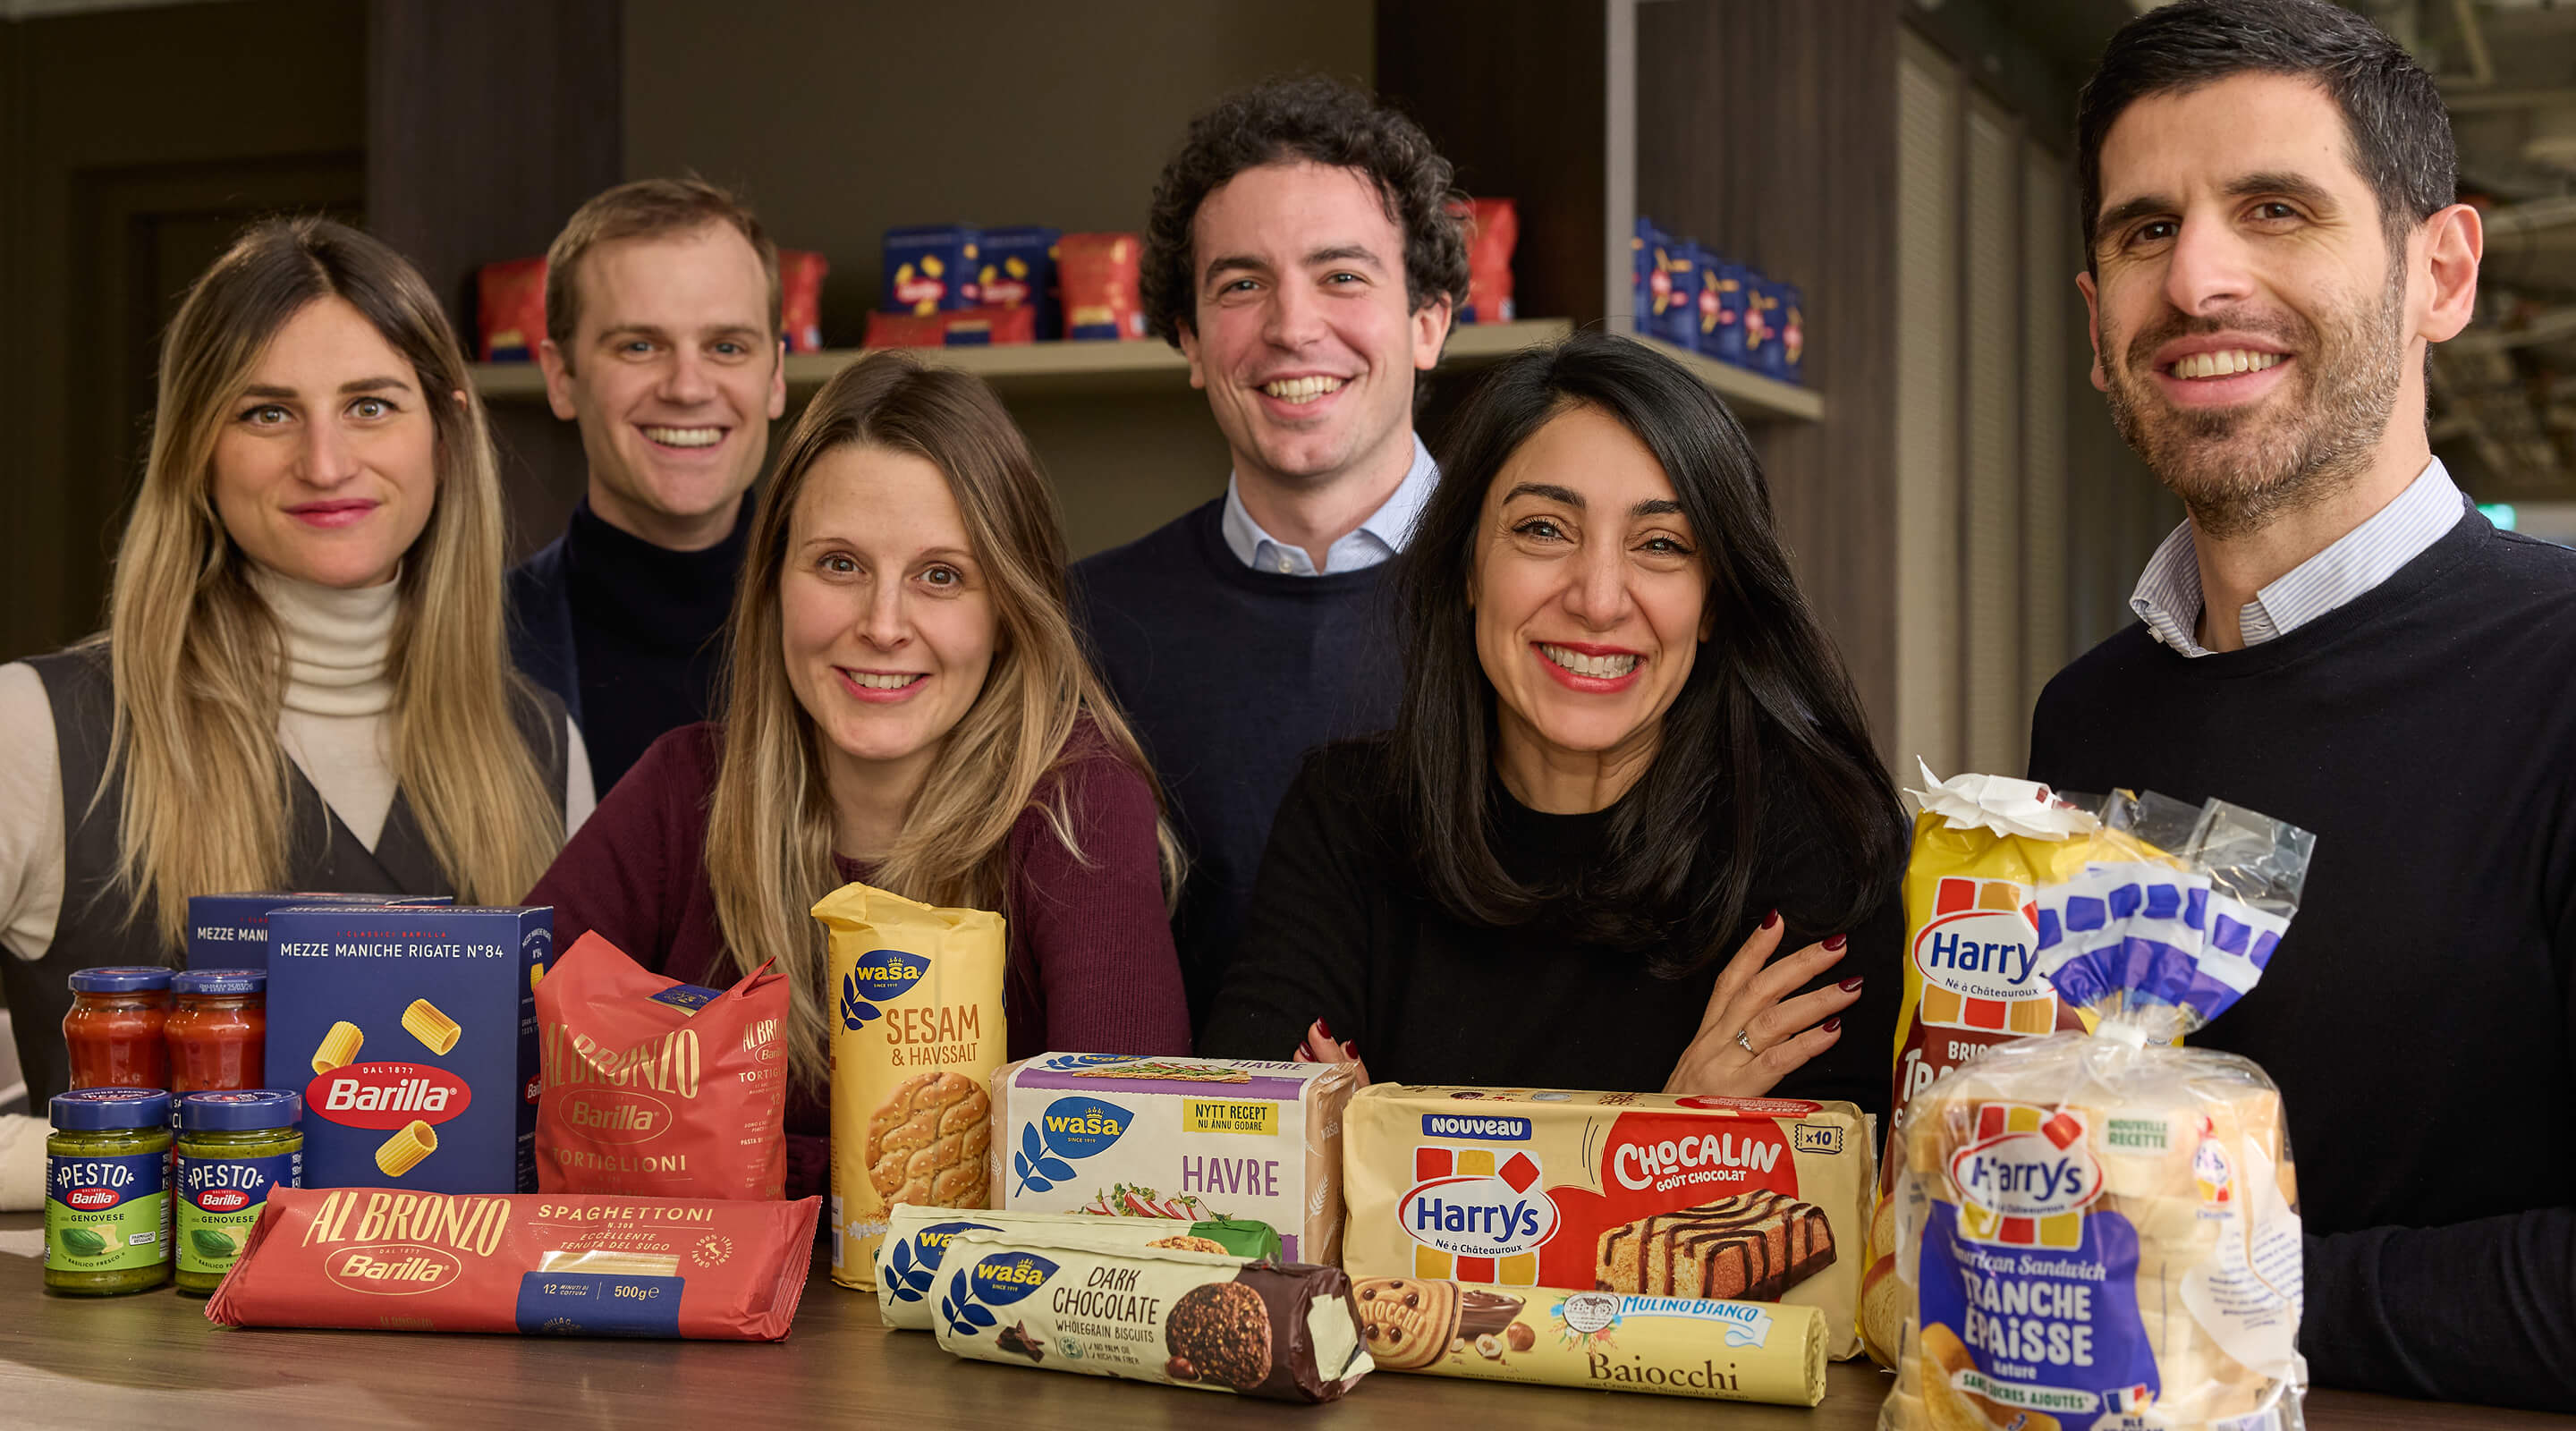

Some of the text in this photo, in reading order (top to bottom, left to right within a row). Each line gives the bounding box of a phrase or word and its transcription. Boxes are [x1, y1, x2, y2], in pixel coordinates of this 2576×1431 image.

[197, 927, 267, 942] MEZZE MANI
[280, 943, 329, 957] MEZZE
[335, 944, 402, 958] MANICHE
[409, 944, 461, 958] RIGATE
[1930, 932, 2040, 985] Harry
[856, 966, 919, 981] wasa
[1945, 977, 1959, 989] Né
[1970, 985, 2038, 997] Châteauroux
[886, 1003, 980, 1046] SESAM
[543, 1022, 700, 1100] AL BRONZO
[892, 1043, 979, 1067] & HAVSSALT
[1231, 1060, 1306, 1071] HAVRE
[326, 1079, 449, 1111] Barilla
[572, 1102, 654, 1130] Barilla
[1195, 1104, 1267, 1121] NYTT RECEPT
[1046, 1115, 1120, 1136] wasa
[1198, 1119, 1208, 1129] NU
[1234, 1121, 1263, 1131] GODARE
[2108, 1132, 2167, 1149] RECETTE
[553, 1147, 686, 1173] TORTIGLIONI
[61, 1164, 128, 1189] PESTO
[192, 1164, 258, 1190] PESTO
[1182, 1155, 1280, 1197] HAVRE
[1970, 1156, 2082, 1201] Harrys
[72, 1192, 114, 1204] Barilla
[202, 1194, 243, 1206] Barilla
[72, 1214, 125, 1222] GENOVESE
[201, 1215, 254, 1224] GENOVESE
[301, 1190, 512, 1257] AL BRONZO
[538, 1204, 714, 1222] SPAGHETTONI
[1417, 1197, 1539, 1243] Harrys
[560, 1241, 605, 1249] TENUTA
[636, 1242, 670, 1250] SUGO
[580, 1232, 657, 1240] ECCELLENTE
[919, 1232, 955, 1248] wa
[1436, 1239, 1523, 1255] Né à Châteauroux
[339, 1254, 444, 1282] Barilla
[978, 1263, 1044, 1286] wasa
[1087, 1266, 1141, 1292] DARK
[2018, 1254, 2106, 1282] Sandwich
[543, 1283, 557, 1295] 12
[1053, 1287, 1160, 1325] CHOCOLATE
[1359, 1300, 1426, 1334] AIOCCHI
[1055, 1318, 1155, 1343] WHOLEGRAIN BISCUITS
[1586, 1351, 1741, 1391] Baiocchi
